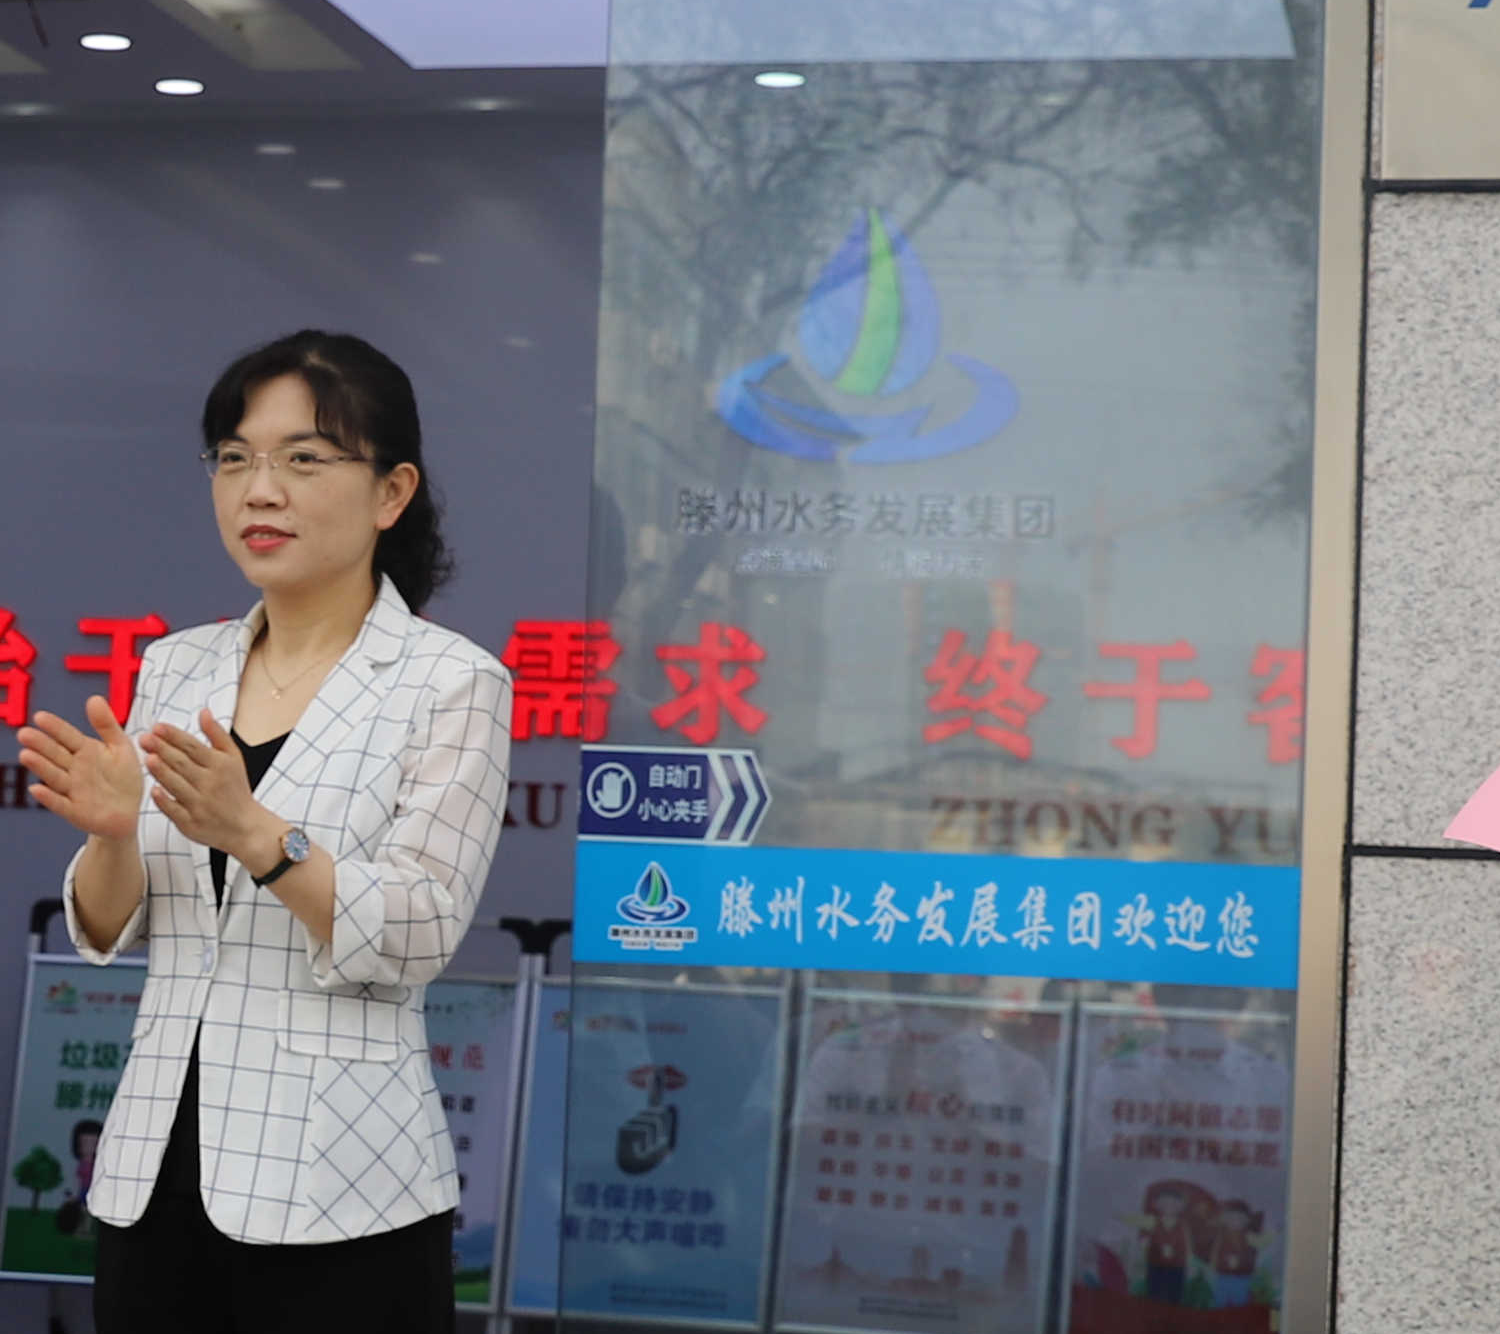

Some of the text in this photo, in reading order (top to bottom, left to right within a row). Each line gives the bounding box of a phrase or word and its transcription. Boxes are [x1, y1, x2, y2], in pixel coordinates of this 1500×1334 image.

[673, 485, 1056, 541] 滕州水务发展集团
[500, 616, 771, 746] 需求
[647, 763, 702, 791] 自动门
[637, 797, 709, 824] 小心夹手
[927, 794, 1178, 851] ZHONG
[717, 872, 1260, 960] 滕州水务发展集团欢迎您
